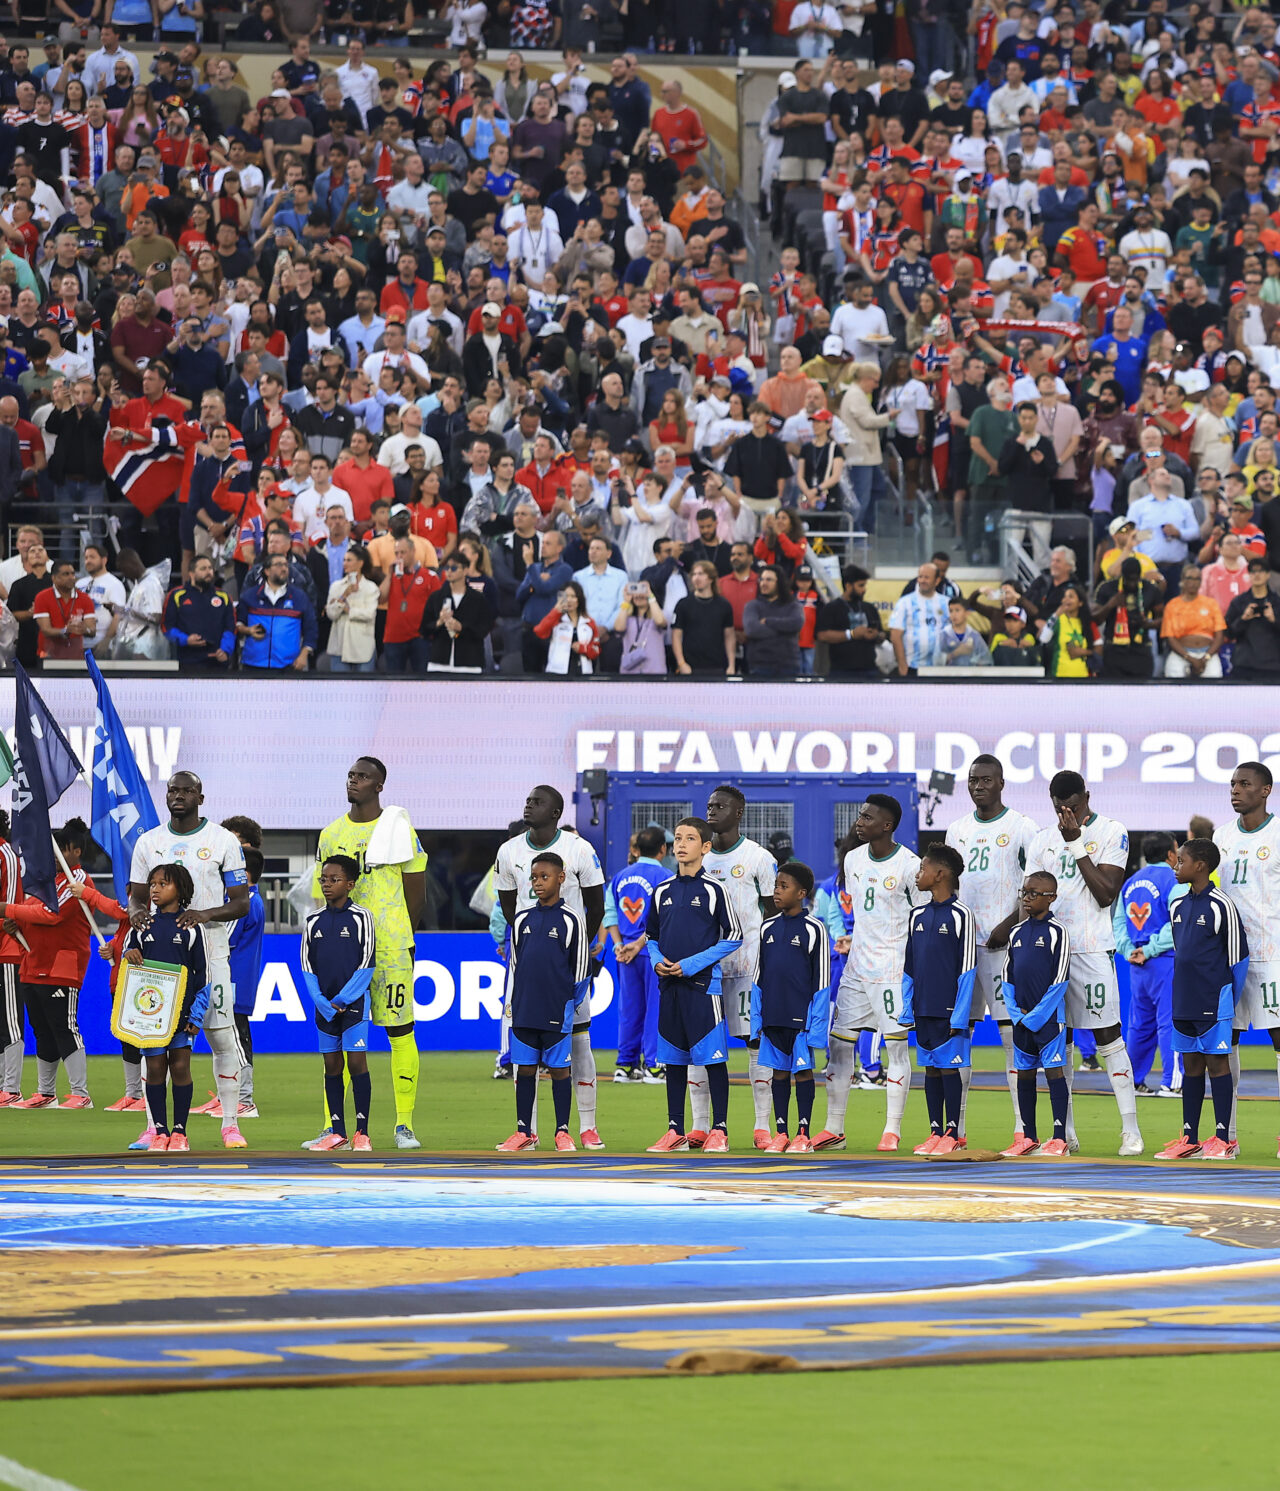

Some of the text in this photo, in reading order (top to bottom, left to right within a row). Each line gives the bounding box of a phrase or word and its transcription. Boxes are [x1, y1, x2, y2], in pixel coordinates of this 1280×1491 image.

[576, 729, 720, 773] FIFA
[732, 730, 981, 783] WORLD
[994, 730, 1129, 784] CUP
[968, 846, 990, 873] 26
[1058, 852, 1077, 880] 19
[1231, 858, 1248, 885] 11
[616, 875, 654, 897] VOLUNTEER
[864, 886, 875, 912] 8
[1124, 879, 1161, 900] VOLUNTEER
[213, 984, 223, 1010] 3
[386, 983, 405, 1009] 16
[412, 960, 614, 1022] ORD
[882, 988, 895, 1015] 8
[1084, 982, 1106, 1010] 19
[1260, 981, 1280, 1009] 11
[0, 1341, 511, 1373] UP
